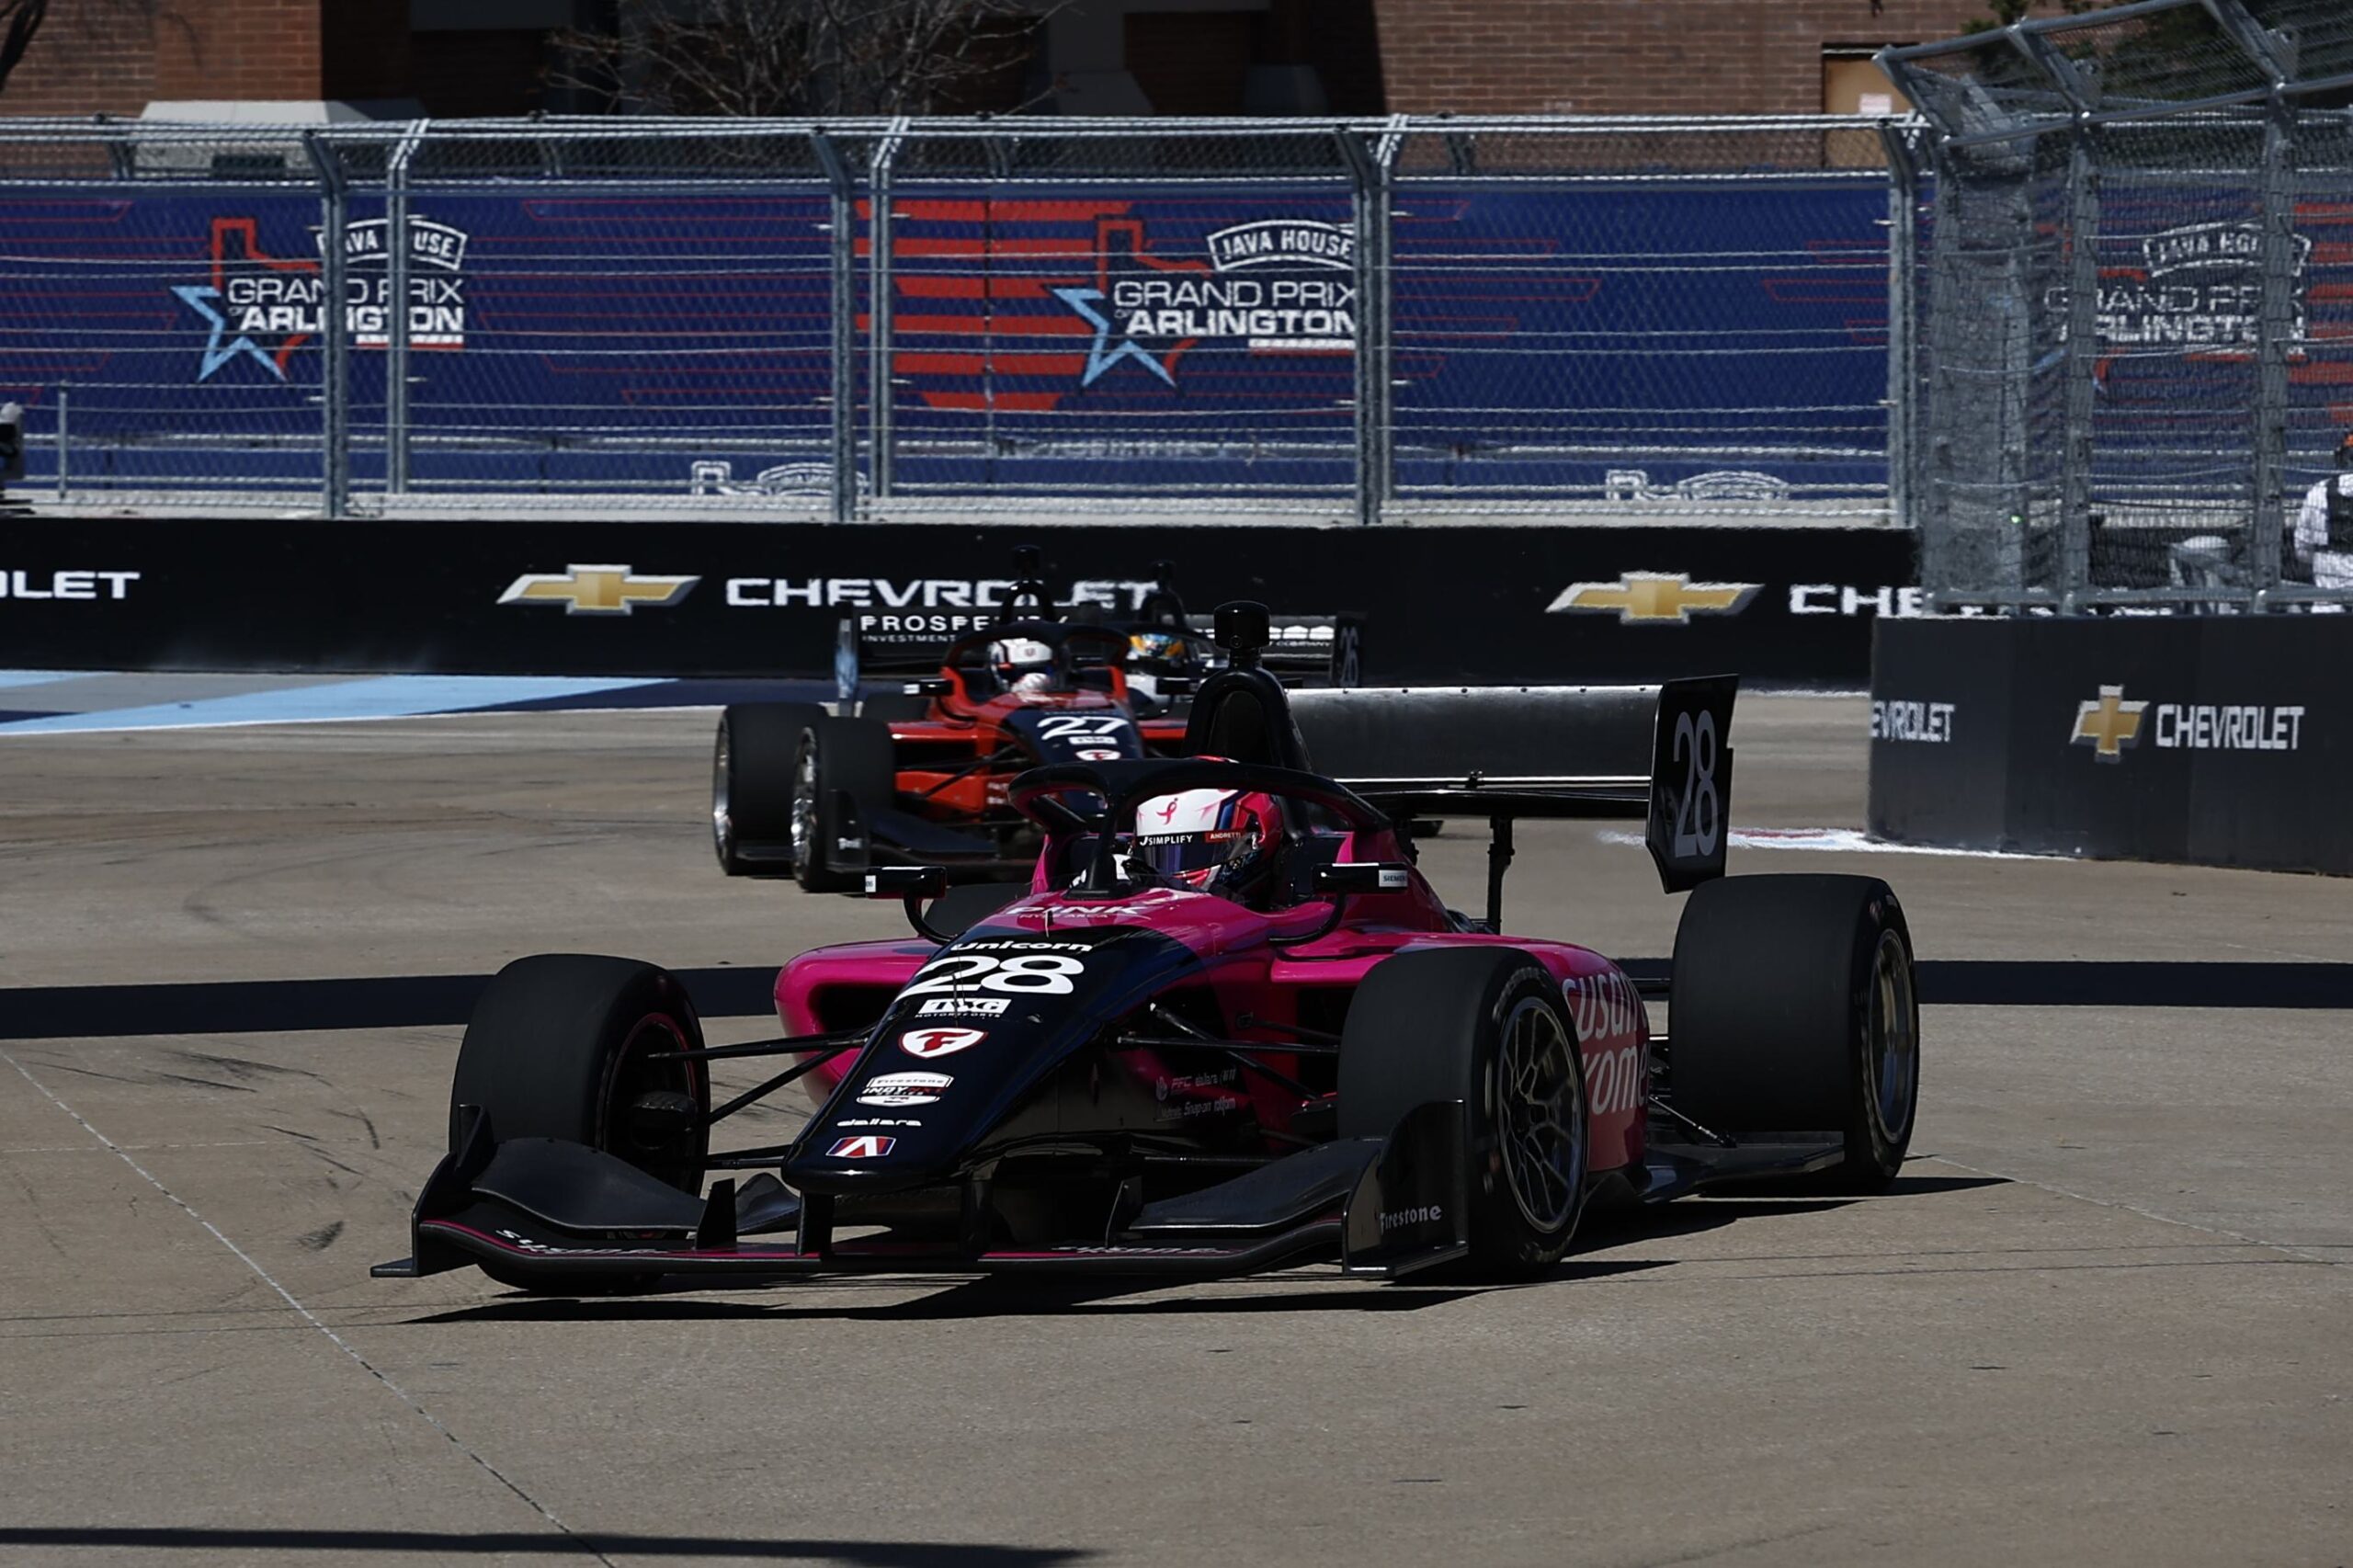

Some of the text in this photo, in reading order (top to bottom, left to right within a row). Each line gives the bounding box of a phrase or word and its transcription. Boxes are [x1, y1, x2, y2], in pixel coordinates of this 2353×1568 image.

[346, 230, 455, 258] AVA USE
[1223, 230, 1355, 260] JAVA HOUSE
[1113, 281, 1356, 308] GRAND PRIX
[2043, 286, 2200, 313] GAND
[239, 306, 464, 332] ARLIGON
[1125, 310, 1356, 335] ARLINGTON
[0, 569, 141, 598] LET
[1036, 715, 1129, 741] 27
[2155, 703, 2305, 750] CHEVROLET
[1673, 710, 1719, 858] 28
[1006, 905, 1147, 915] PINK
[893, 955, 1086, 1004] 28
[861, 1086, 910, 1095] INDY
[1379, 1204, 1443, 1236] Firestone
